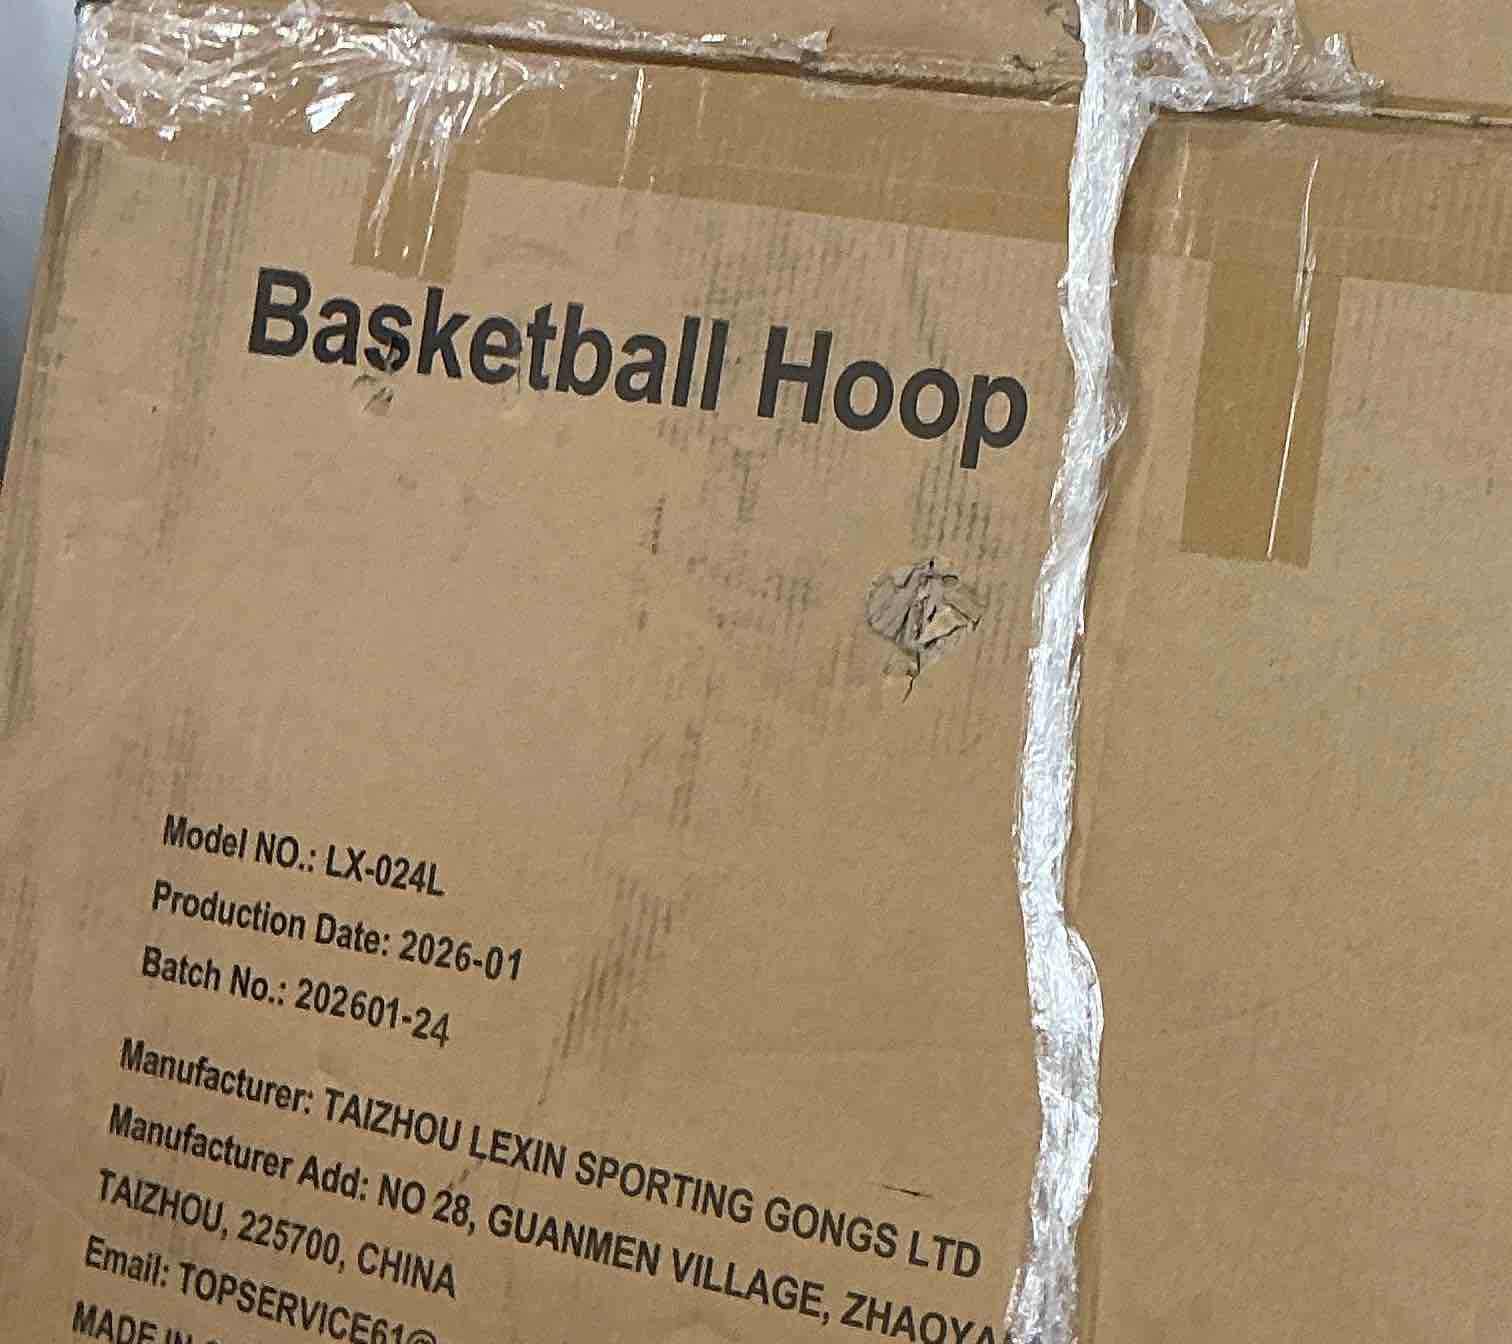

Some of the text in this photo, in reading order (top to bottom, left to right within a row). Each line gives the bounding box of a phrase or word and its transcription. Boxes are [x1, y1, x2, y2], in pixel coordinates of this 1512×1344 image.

[248, 266, 1028, 469] Basketball Hoop
[163, 815, 445, 897] Model NO.: LX-024L
[152, 880, 523, 981] Production Date: 2026-01
[142, 945, 451, 1048] Batch No.: 202601-24
[108, 1103, 292, 1182] Manufacturer
[297, 1156, 368, 1202] Add:
[378, 1173, 426, 1213] NO
[433, 1191, 475, 1235] 28,
[488, 1203, 661, 1277] GUANMEN
[672, 1248, 830, 1326] VILLAGE,
[120, 1038, 981, 1278] Manufacturer: TAIZHOU LEXIN SPORTING GONGS LTD
[84, 1236, 169, 1288] Email:
[98, 1168, 457, 1297] TAIZHOU, 225700, CHINA
